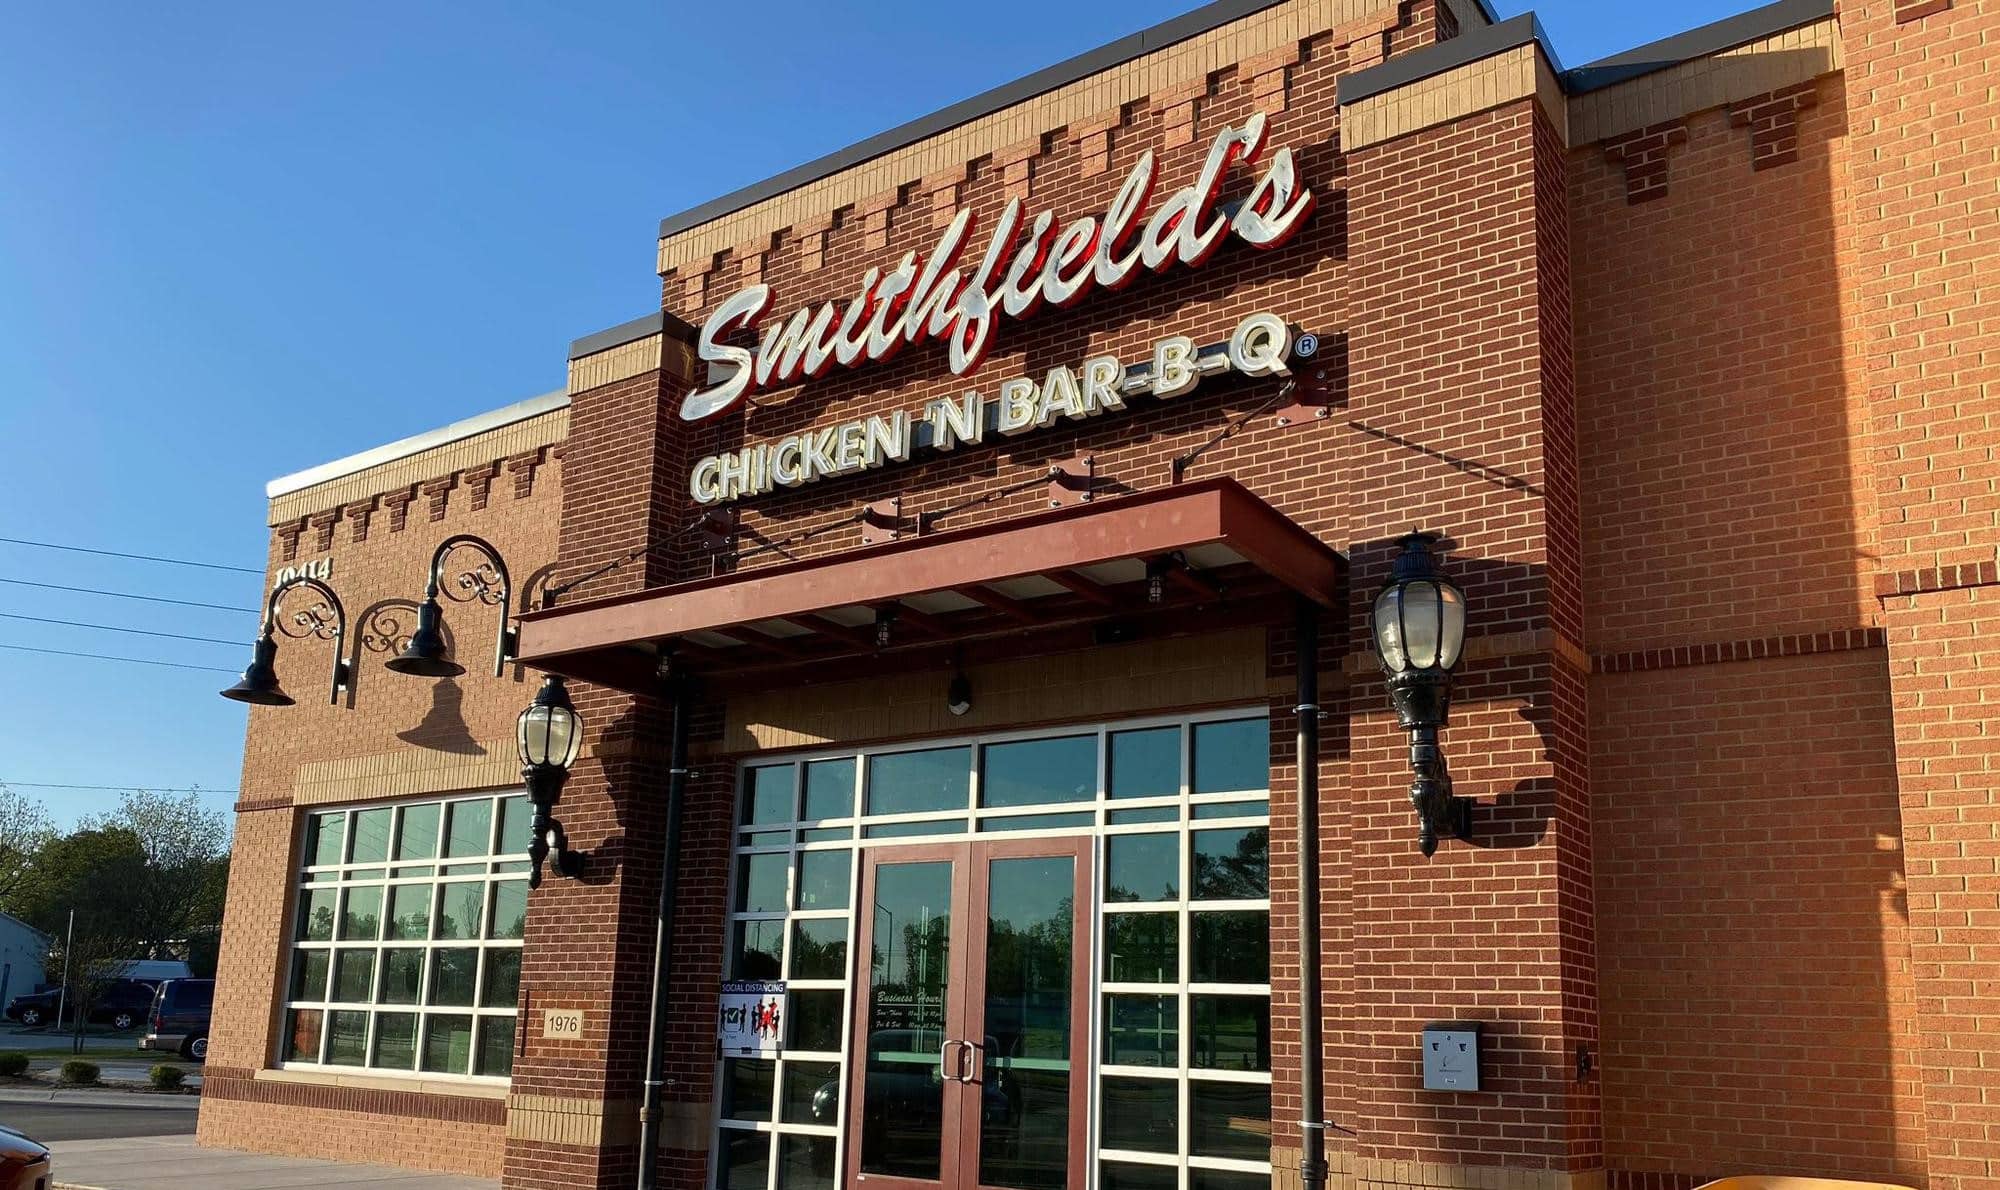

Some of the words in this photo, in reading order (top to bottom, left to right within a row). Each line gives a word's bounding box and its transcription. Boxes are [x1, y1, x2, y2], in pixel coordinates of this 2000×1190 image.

[679, 111, 1317, 421] Smithfield's
[690, 409, 911, 503] CHICKEN
[999, 311, 1293, 437] BAR-B-Q
[721, 983, 744, 993] SOCIAL
[745, 983, 784, 993] DISTANCING
[877, 991, 913, 1002] Business
[549, 1015, 578, 1032] 1976
